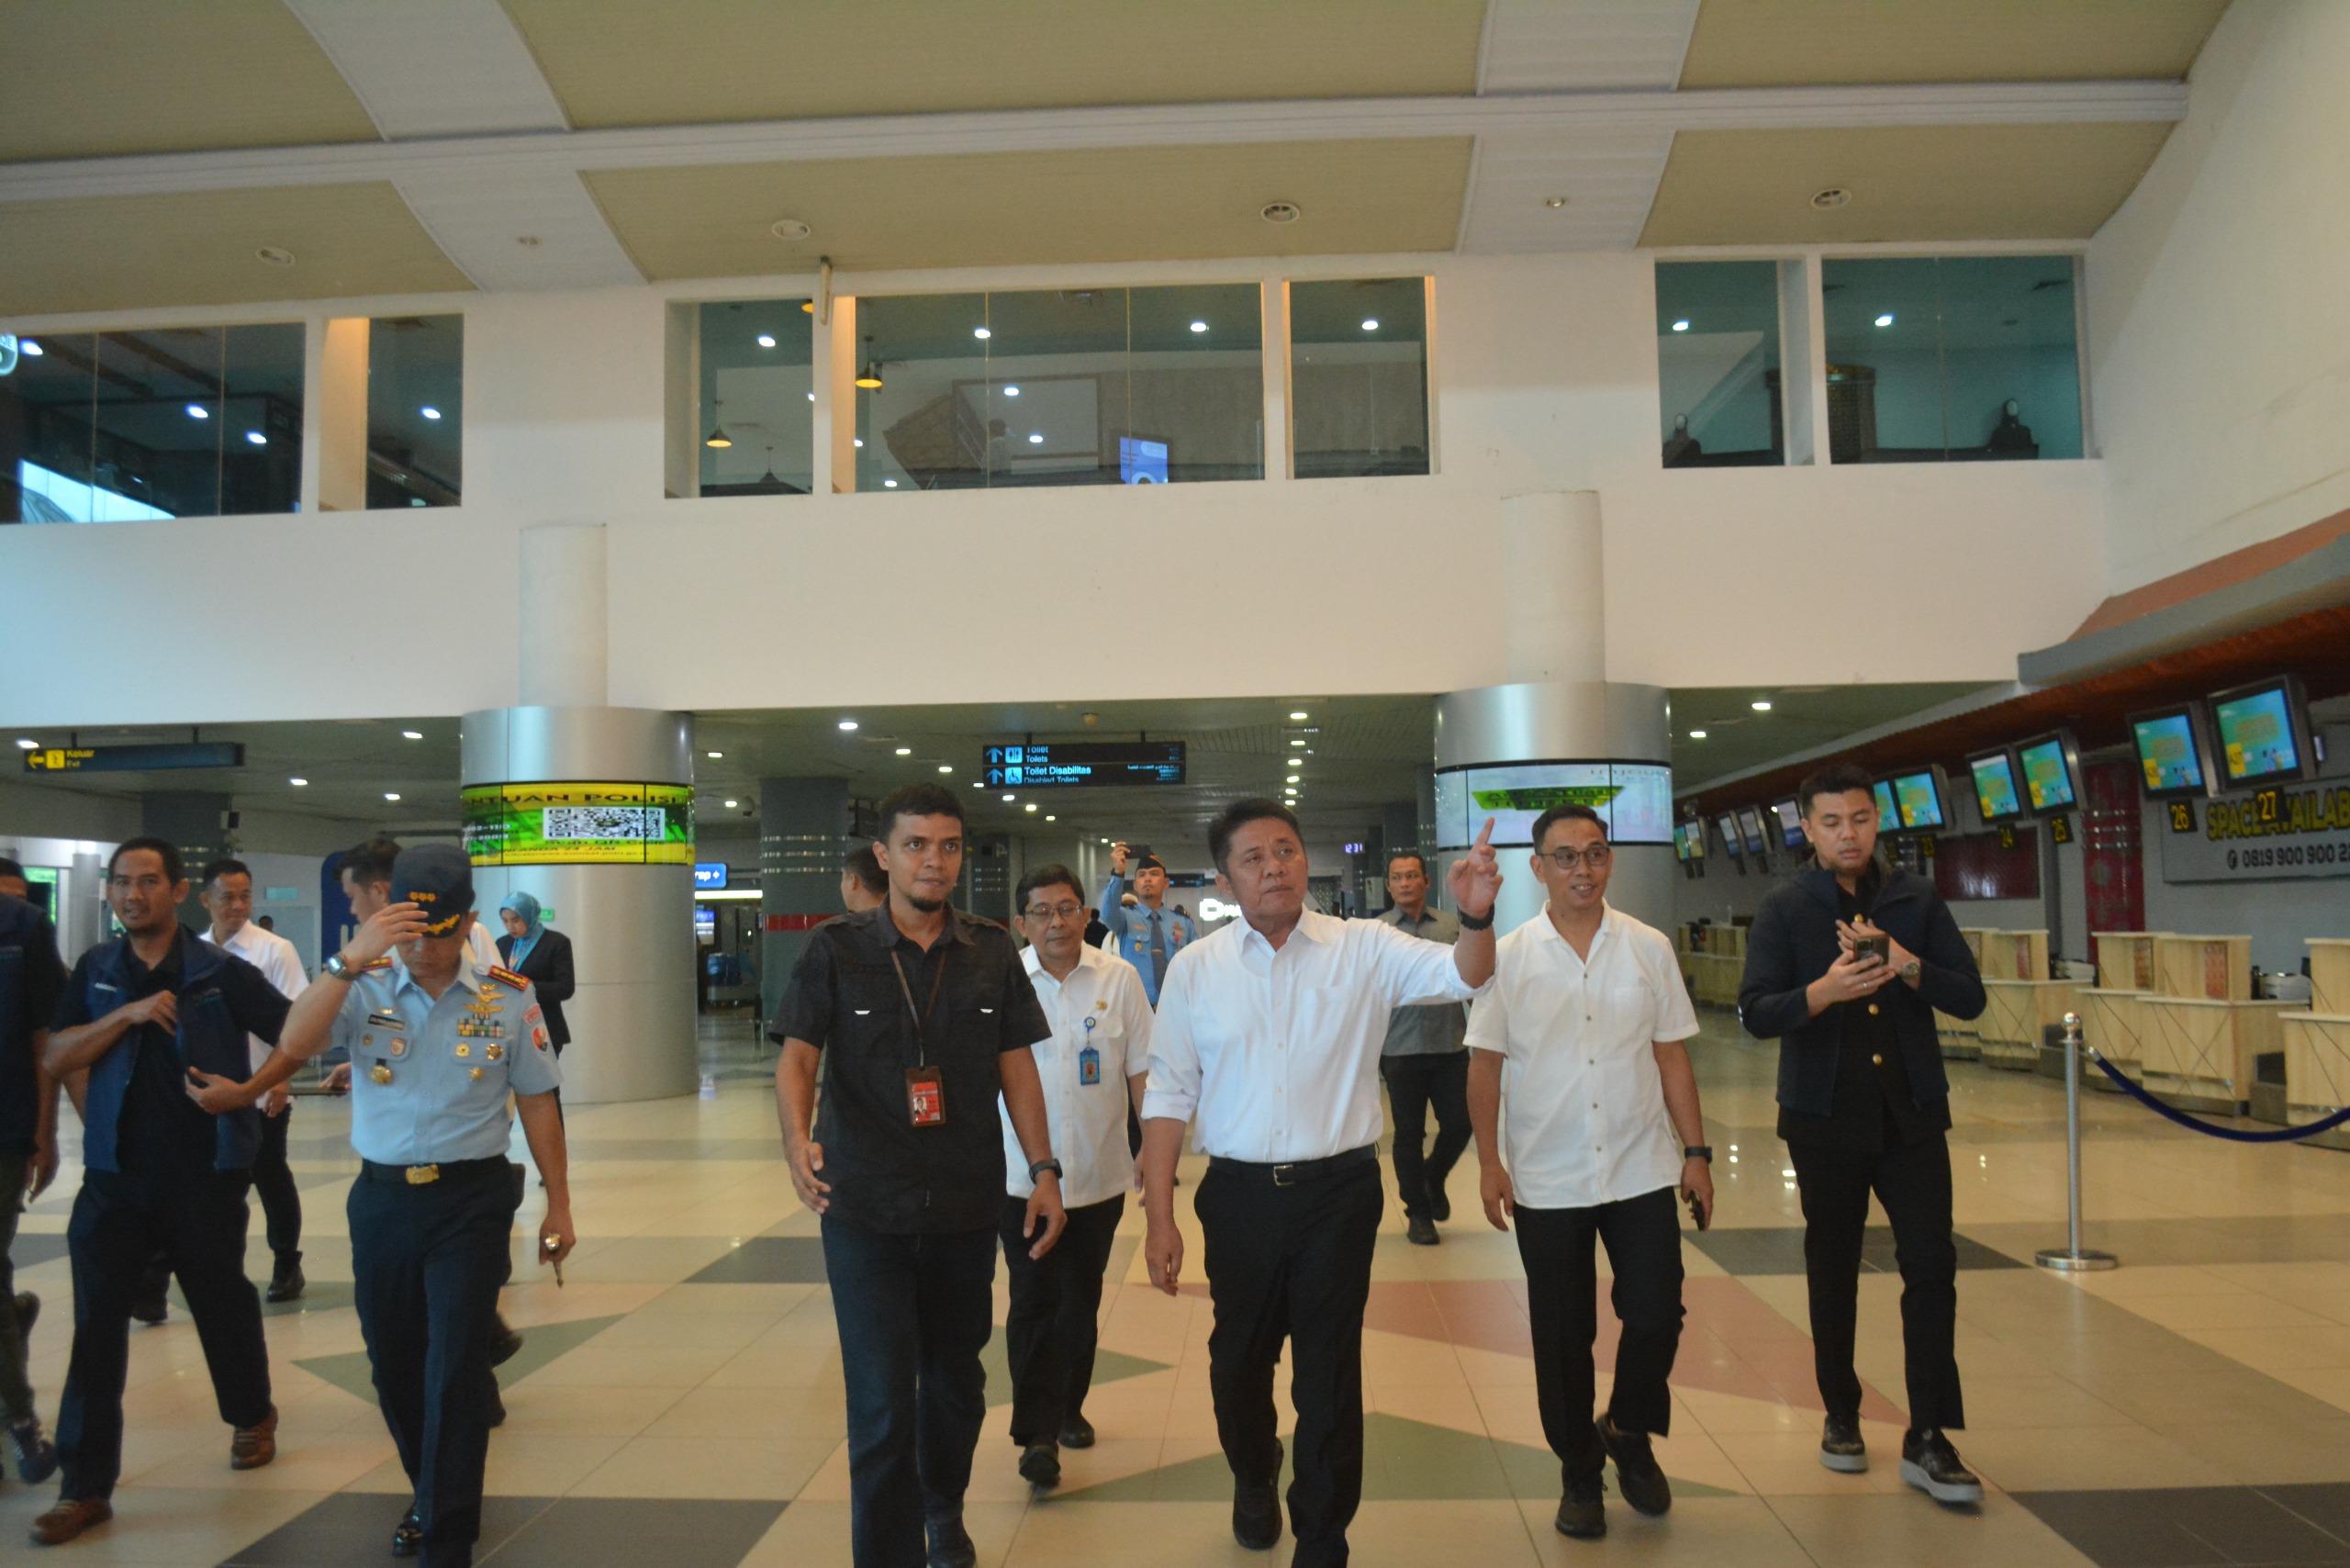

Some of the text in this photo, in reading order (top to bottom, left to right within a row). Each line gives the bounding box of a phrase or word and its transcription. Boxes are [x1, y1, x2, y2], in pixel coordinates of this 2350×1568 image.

[1026, 755, 1048, 763] Toilets
[1024, 765, 1091, 776] Toilet Disabilitas
[585, 793, 677, 804] POLISI
[2257, 791, 2277, 821] 27
[2170, 804, 2189, 830] 26
[2243, 847, 2274, 868] 0819
[2277, 845, 2303, 867] 900
[2307, 843, 2336, 864] 900
